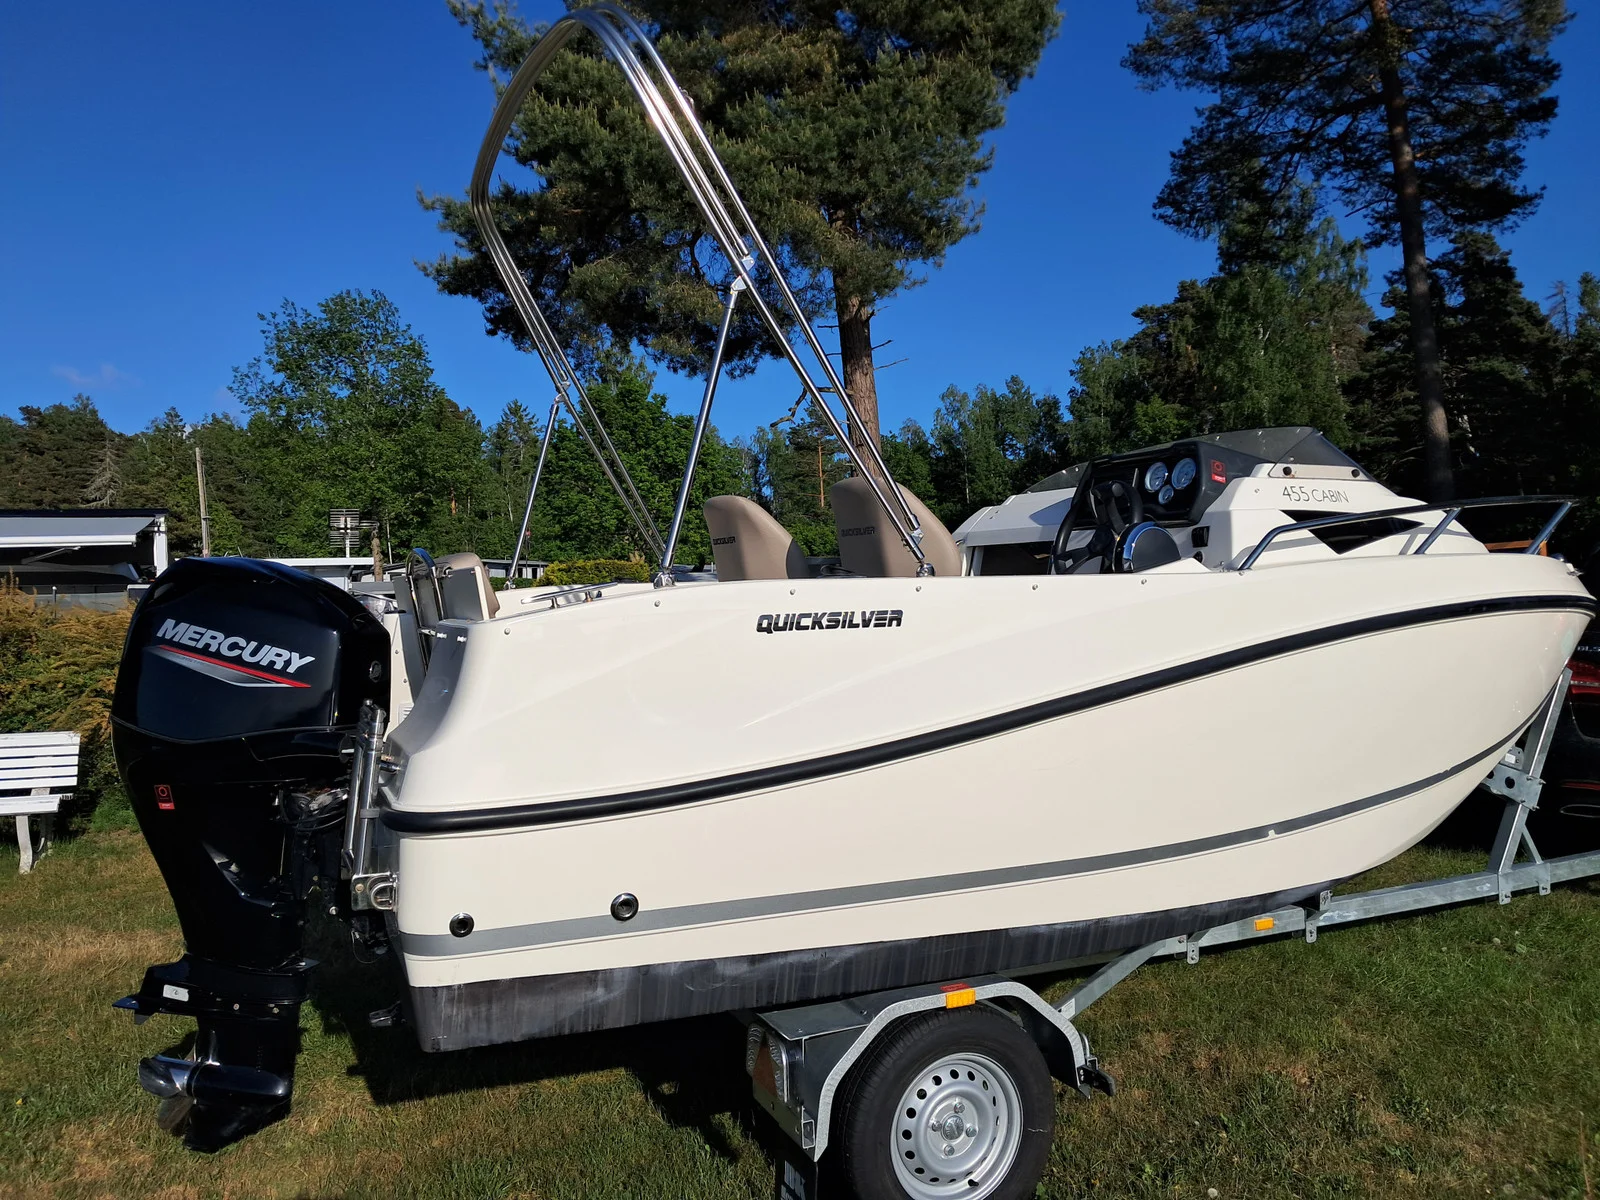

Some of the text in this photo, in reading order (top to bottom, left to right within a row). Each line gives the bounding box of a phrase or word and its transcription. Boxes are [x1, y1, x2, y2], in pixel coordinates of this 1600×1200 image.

[1282, 486, 1349, 503] 455 CABIN
[756, 609, 904, 635] QUICKSILVER
[156, 618, 315, 674] MERCURY
